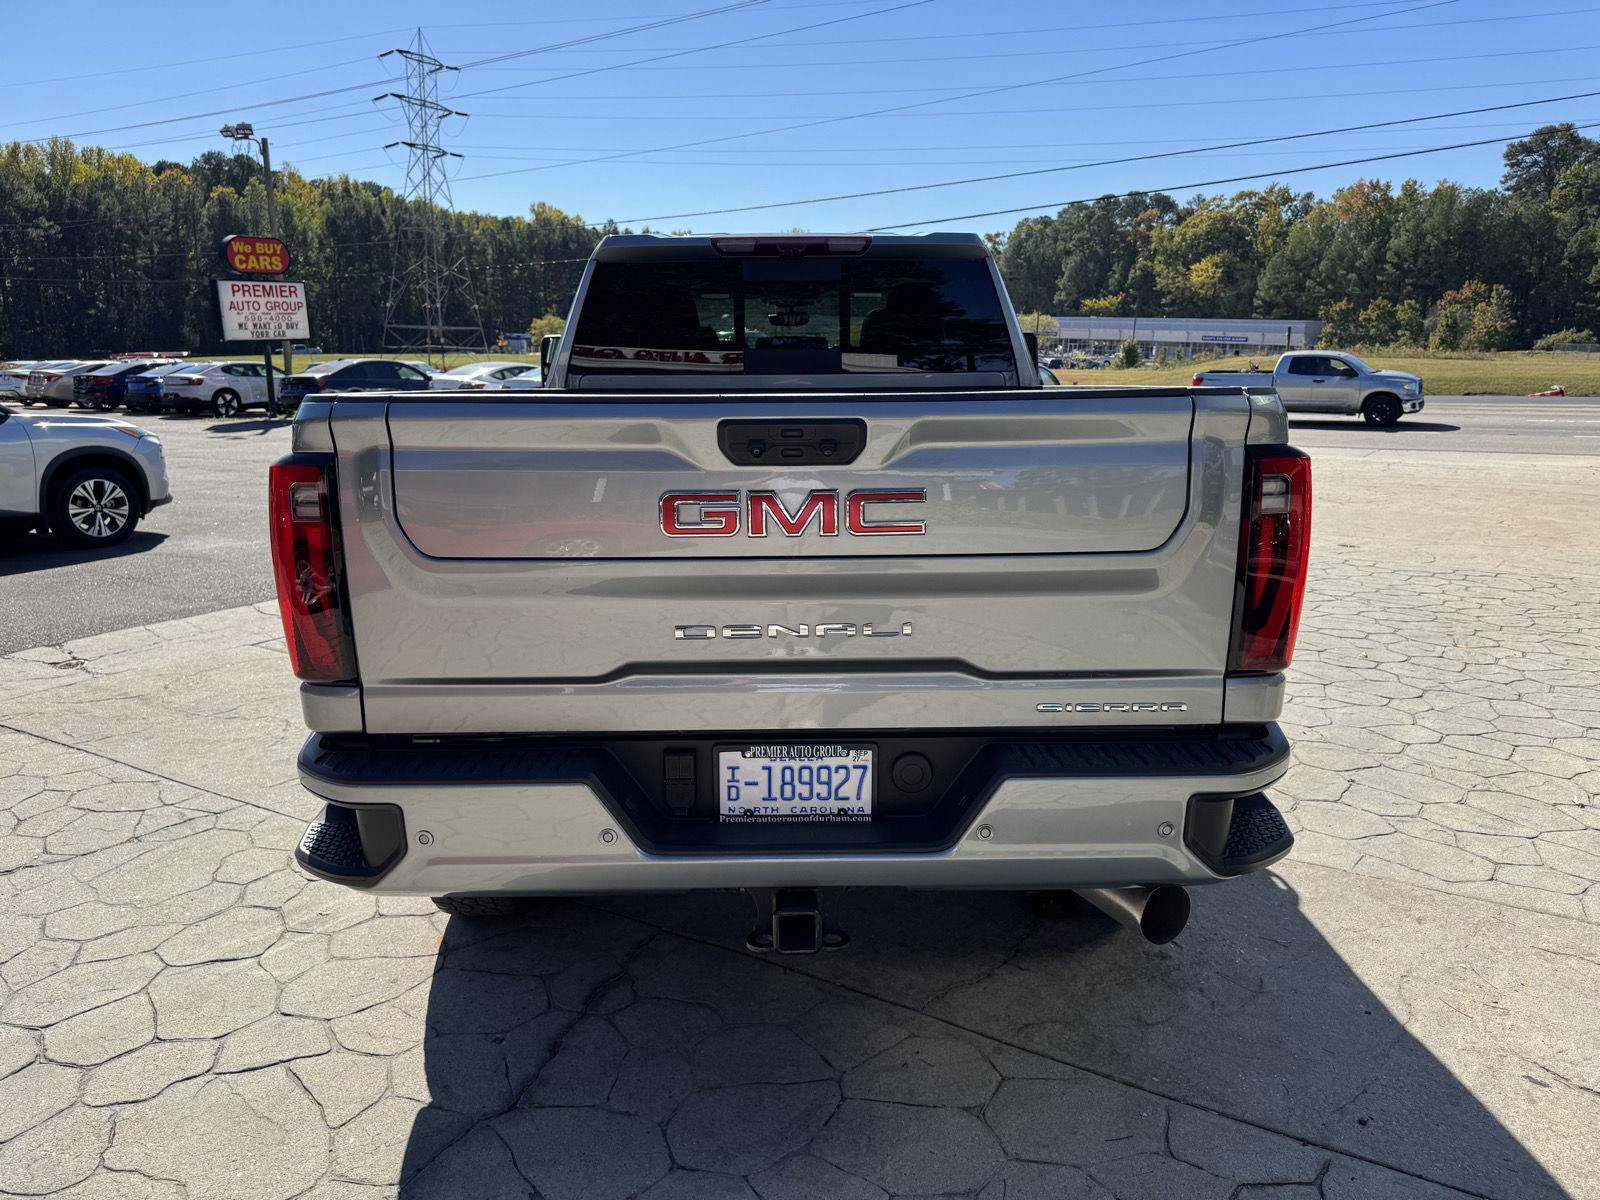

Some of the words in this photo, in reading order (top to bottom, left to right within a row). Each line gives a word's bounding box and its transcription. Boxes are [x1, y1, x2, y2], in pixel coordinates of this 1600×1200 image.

[232, 241, 251, 253] We
[256, 242, 282, 254] BUY
[235, 254, 282, 270] CARS
[231, 283, 298, 298] PREMIER
[229, 300, 261, 312] AUTO
[265, 301, 304, 312] GROUP
[252, 322, 271, 330] WANT
[286, 322, 300, 330] BUY
[250, 330, 270, 338] YOUR
[659, 488, 928, 538] GMC
[674, 622, 912, 640] DENALI
[1036, 702, 1188, 713] SIERRA
[750, 746, 788, 758] PREMIER
[789, 745, 812, 758] AUTO
[813, 745, 843, 758] GROUP
